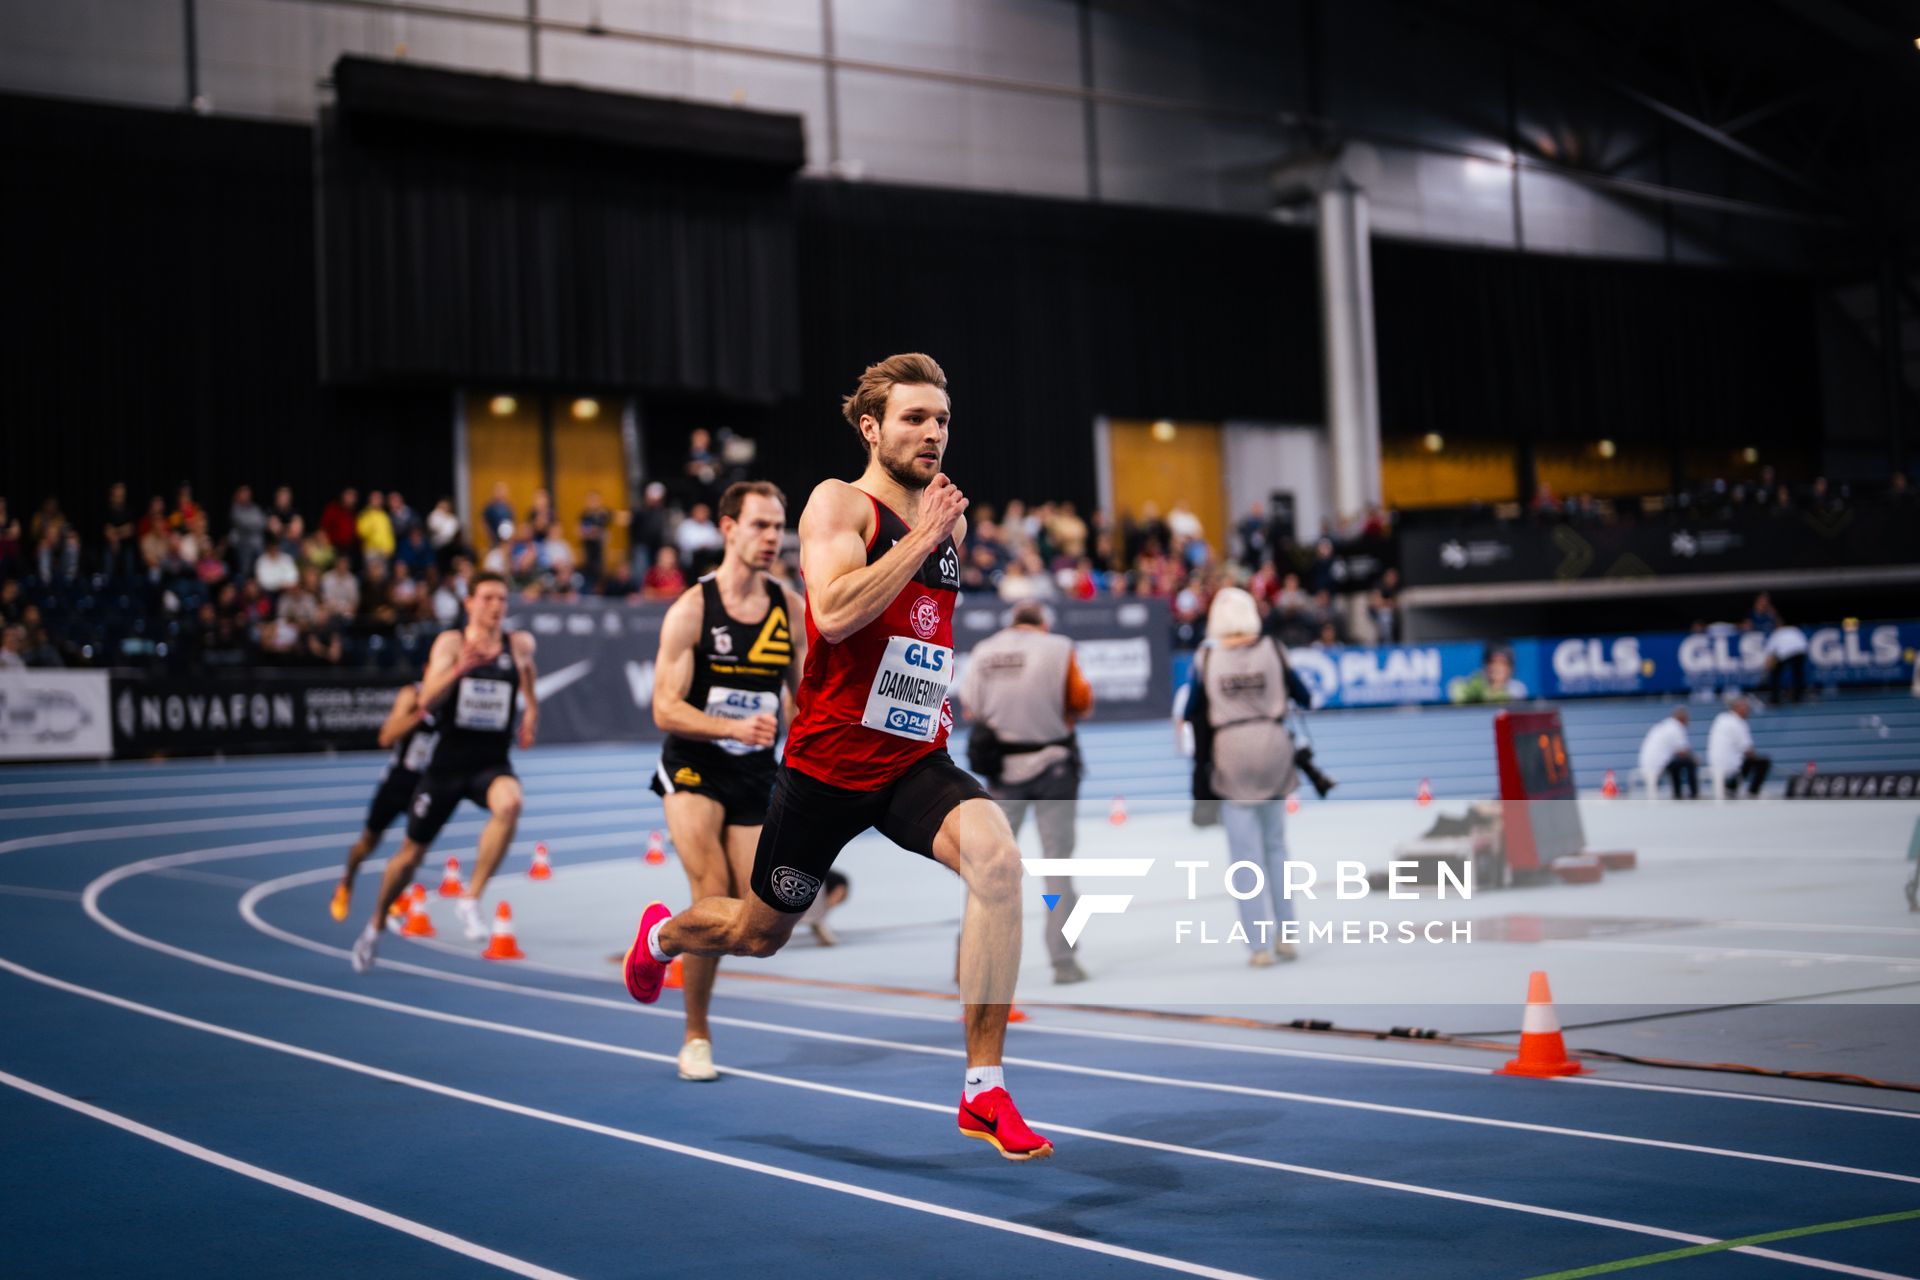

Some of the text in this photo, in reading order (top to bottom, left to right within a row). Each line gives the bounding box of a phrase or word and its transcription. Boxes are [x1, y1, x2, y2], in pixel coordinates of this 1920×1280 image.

[1339, 648, 1441, 683] PLAN
[140, 694, 295, 731] NOVAFON
[726, 692, 762, 711] GLS
[1811, 775, 1920, 798] NOVAFO
